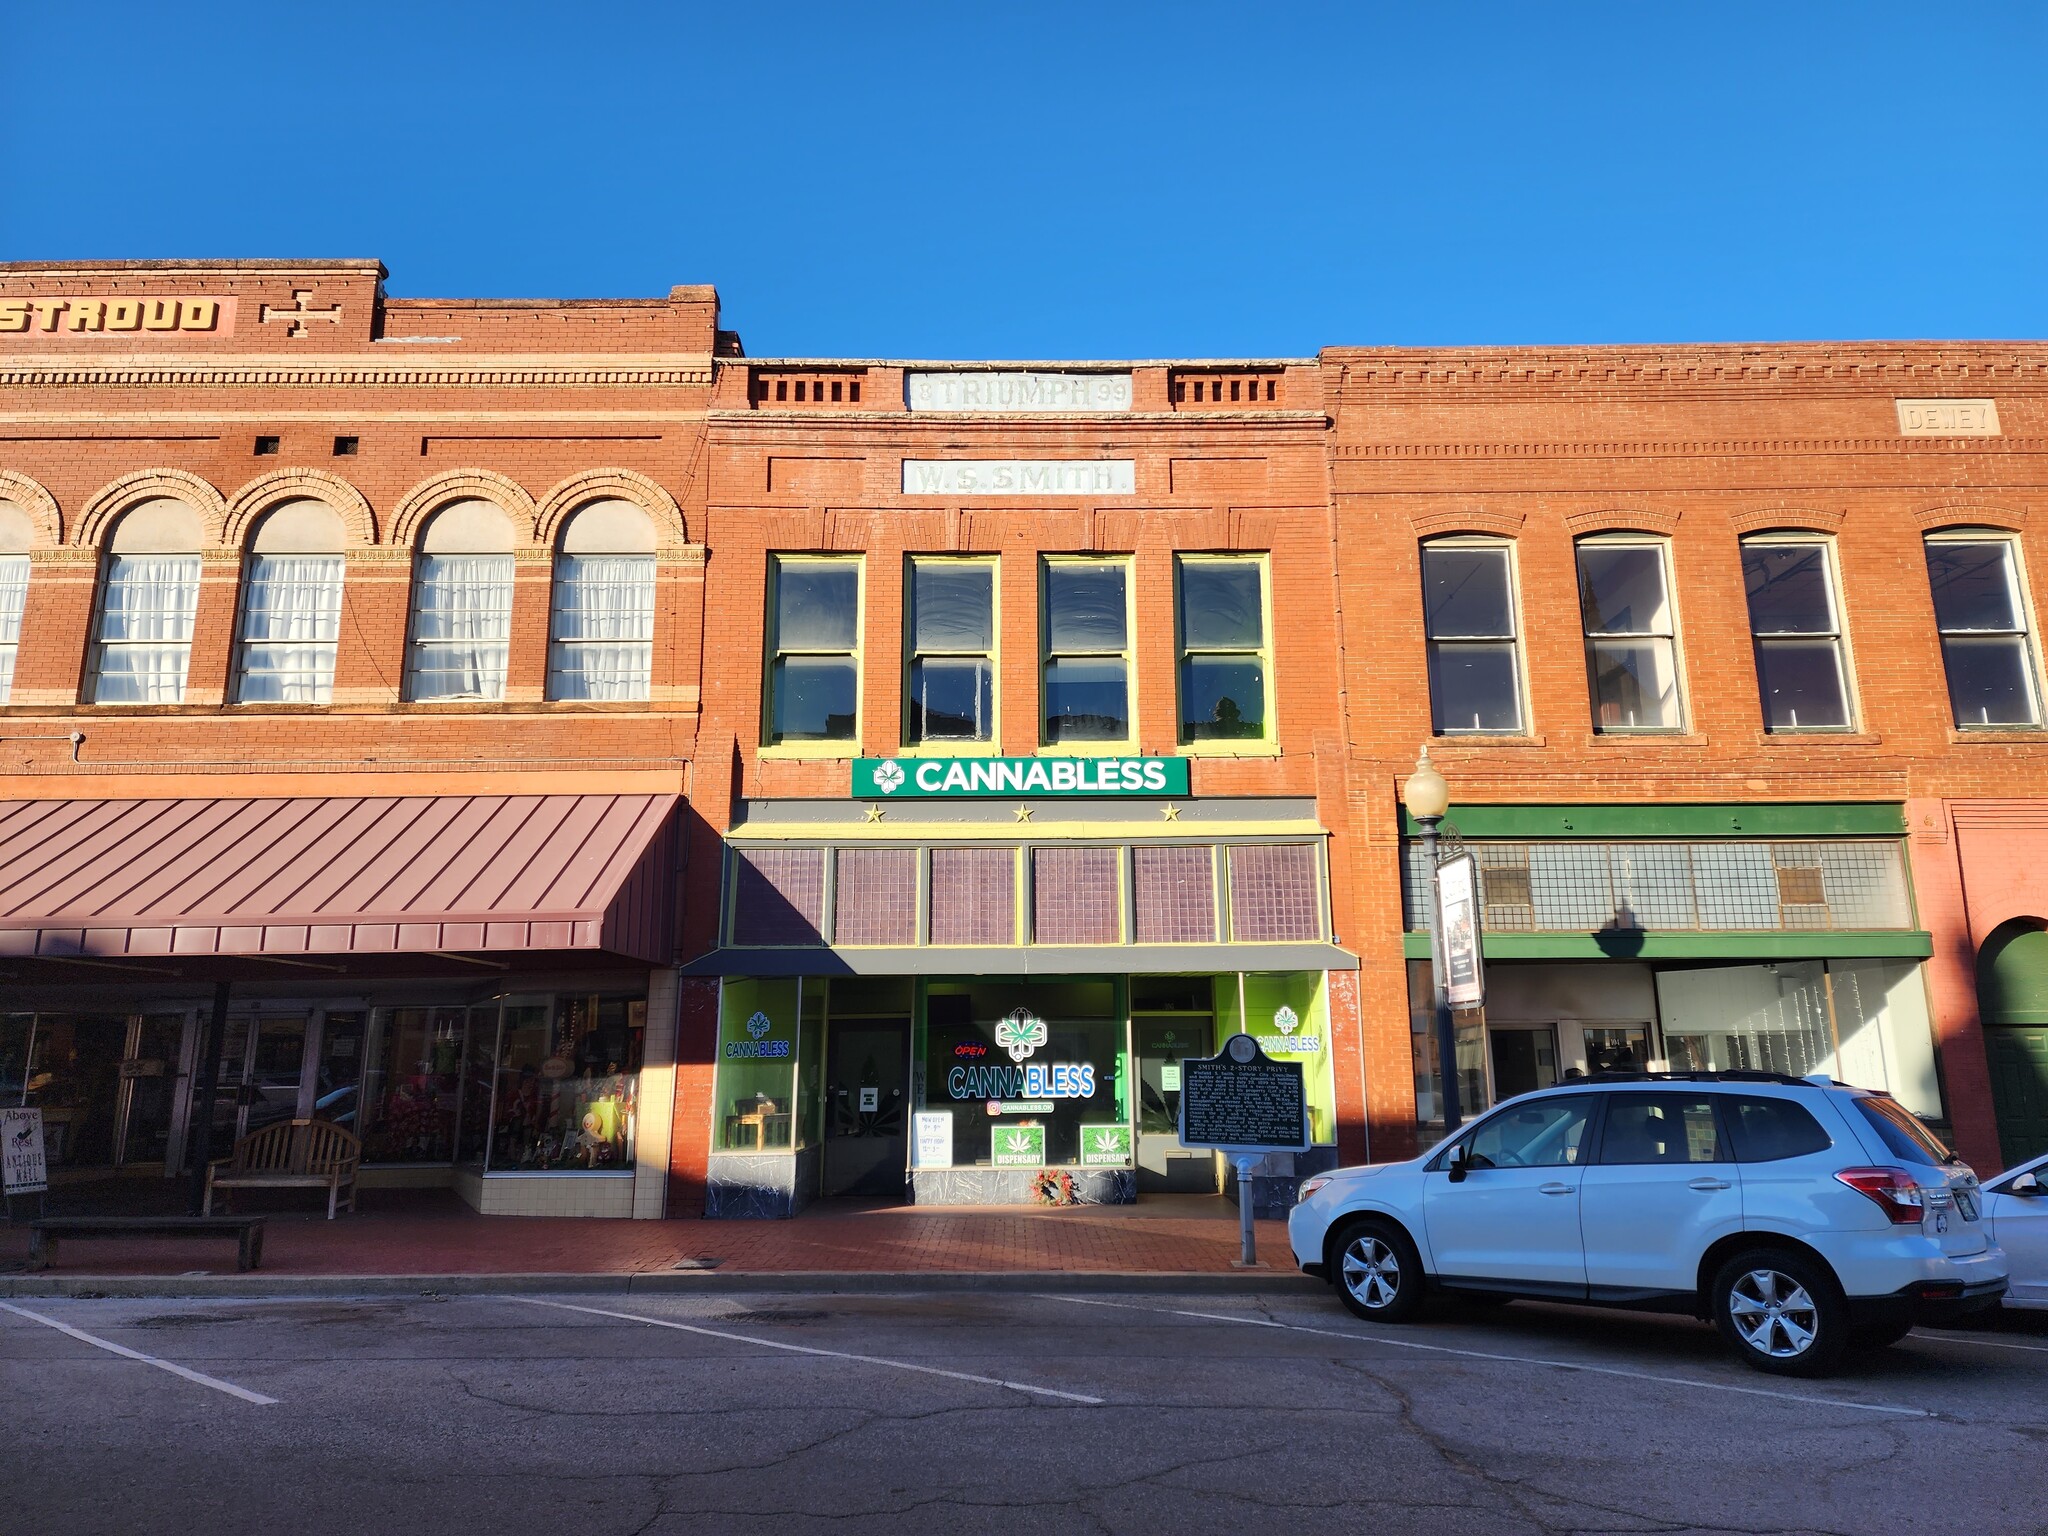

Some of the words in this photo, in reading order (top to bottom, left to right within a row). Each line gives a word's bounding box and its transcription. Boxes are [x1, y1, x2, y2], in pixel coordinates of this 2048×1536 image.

[0, 299, 219, 332] STROUD
[940, 379, 1090, 405] TRIUMPH
[1097, 383, 1126, 402] 99
[1909, 408, 1986, 430] DEWEY
[916, 761, 1166, 791] CANNABLESS
[726, 1041, 790, 1058] CANNABLESS
[955, 1046, 987, 1056] OPEN
[948, 1065, 1094, 1099] CANNABLESS
[4, 1110, 38, 1124] Above
[12, 1137, 33, 1151] Rest
[6, 1153, 42, 1168] ANTIQUE
[997, 1154, 1041, 1164] DISPENSARY
[16, 1168, 38, 1183] MALL
